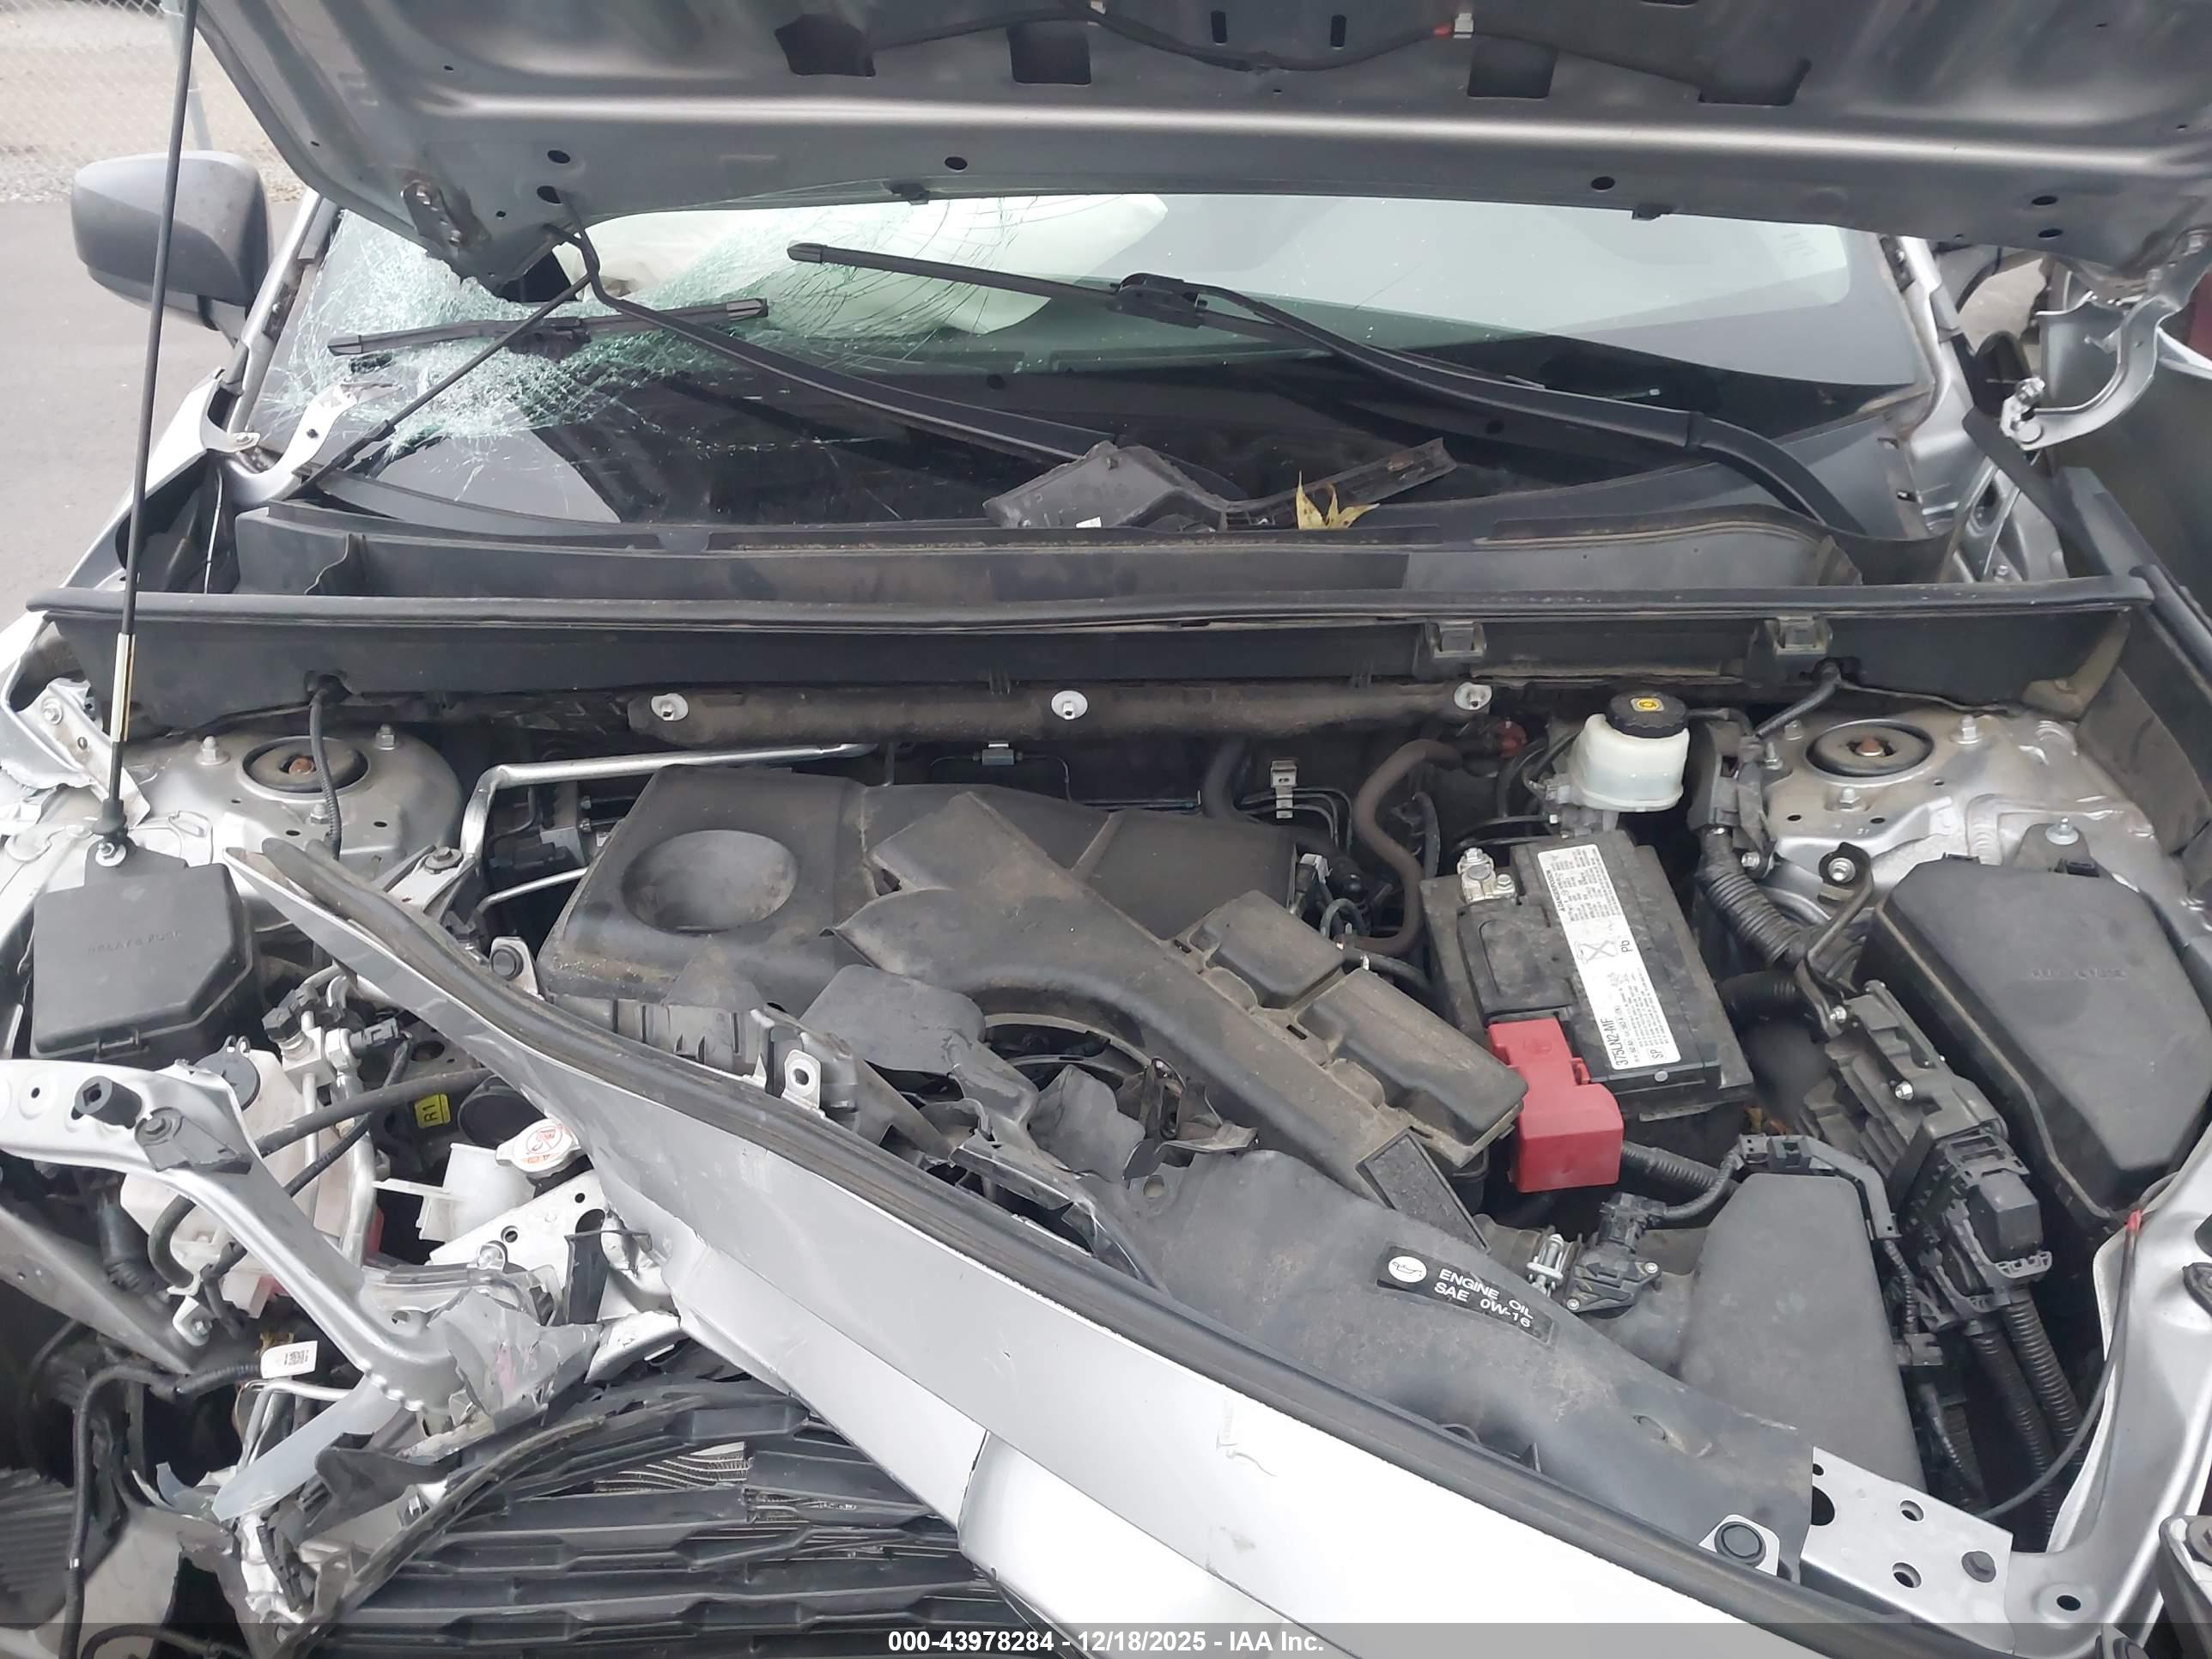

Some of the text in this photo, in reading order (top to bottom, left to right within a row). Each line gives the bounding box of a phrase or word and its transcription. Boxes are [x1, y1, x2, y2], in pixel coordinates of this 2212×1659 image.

[1620, 939, 1634, 953] Pb
[1600, 1018, 1629, 1066] 375LN2-MF
[1650, 1048, 1665, 1060] SP
[422, 1104, 438, 1121] R1
[1434, 1282, 1532, 1328] SAE 0W-16
[1438, 1268, 1534, 1320] ENGINE OIL
